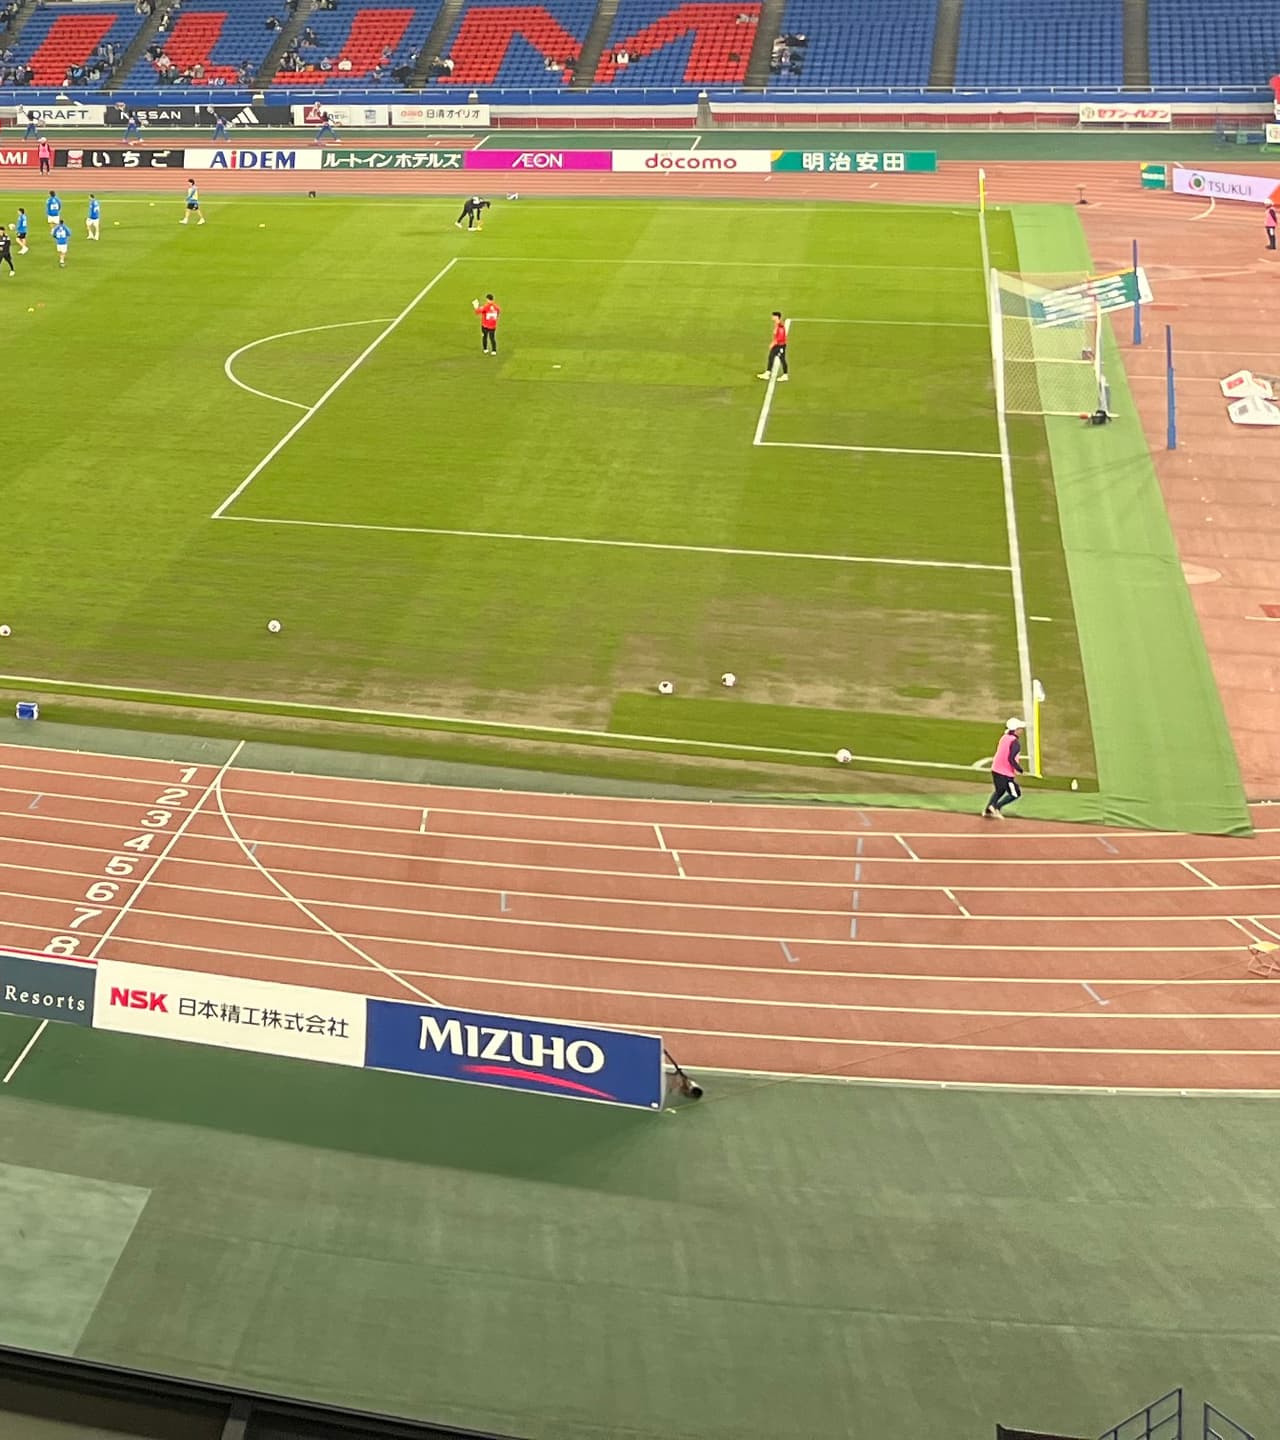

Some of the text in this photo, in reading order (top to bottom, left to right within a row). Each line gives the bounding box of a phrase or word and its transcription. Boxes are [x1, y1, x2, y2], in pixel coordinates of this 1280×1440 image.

[92, 150, 171, 168] いちご
[645, 153, 737, 169] docomo
[802, 152, 905, 172] 明治安田
[1207, 181, 1252, 197] TSUKUI
[179, 767, 198, 783] 1
[155, 788, 189, 806] 2
[141, 810, 172, 828] 3
[123, 833, 155, 852] 4
[105, 855, 139, 876] 5
[85, 881, 120, 902] 6
[69, 906, 103, 929] 7
[43, 935, 80, 956] 8
[4, 984, 85, 1011] Resorts
[110, 987, 349, 1039] NSK 日本精工株式会社
[419, 1015, 605, 1074] MIZUHO
